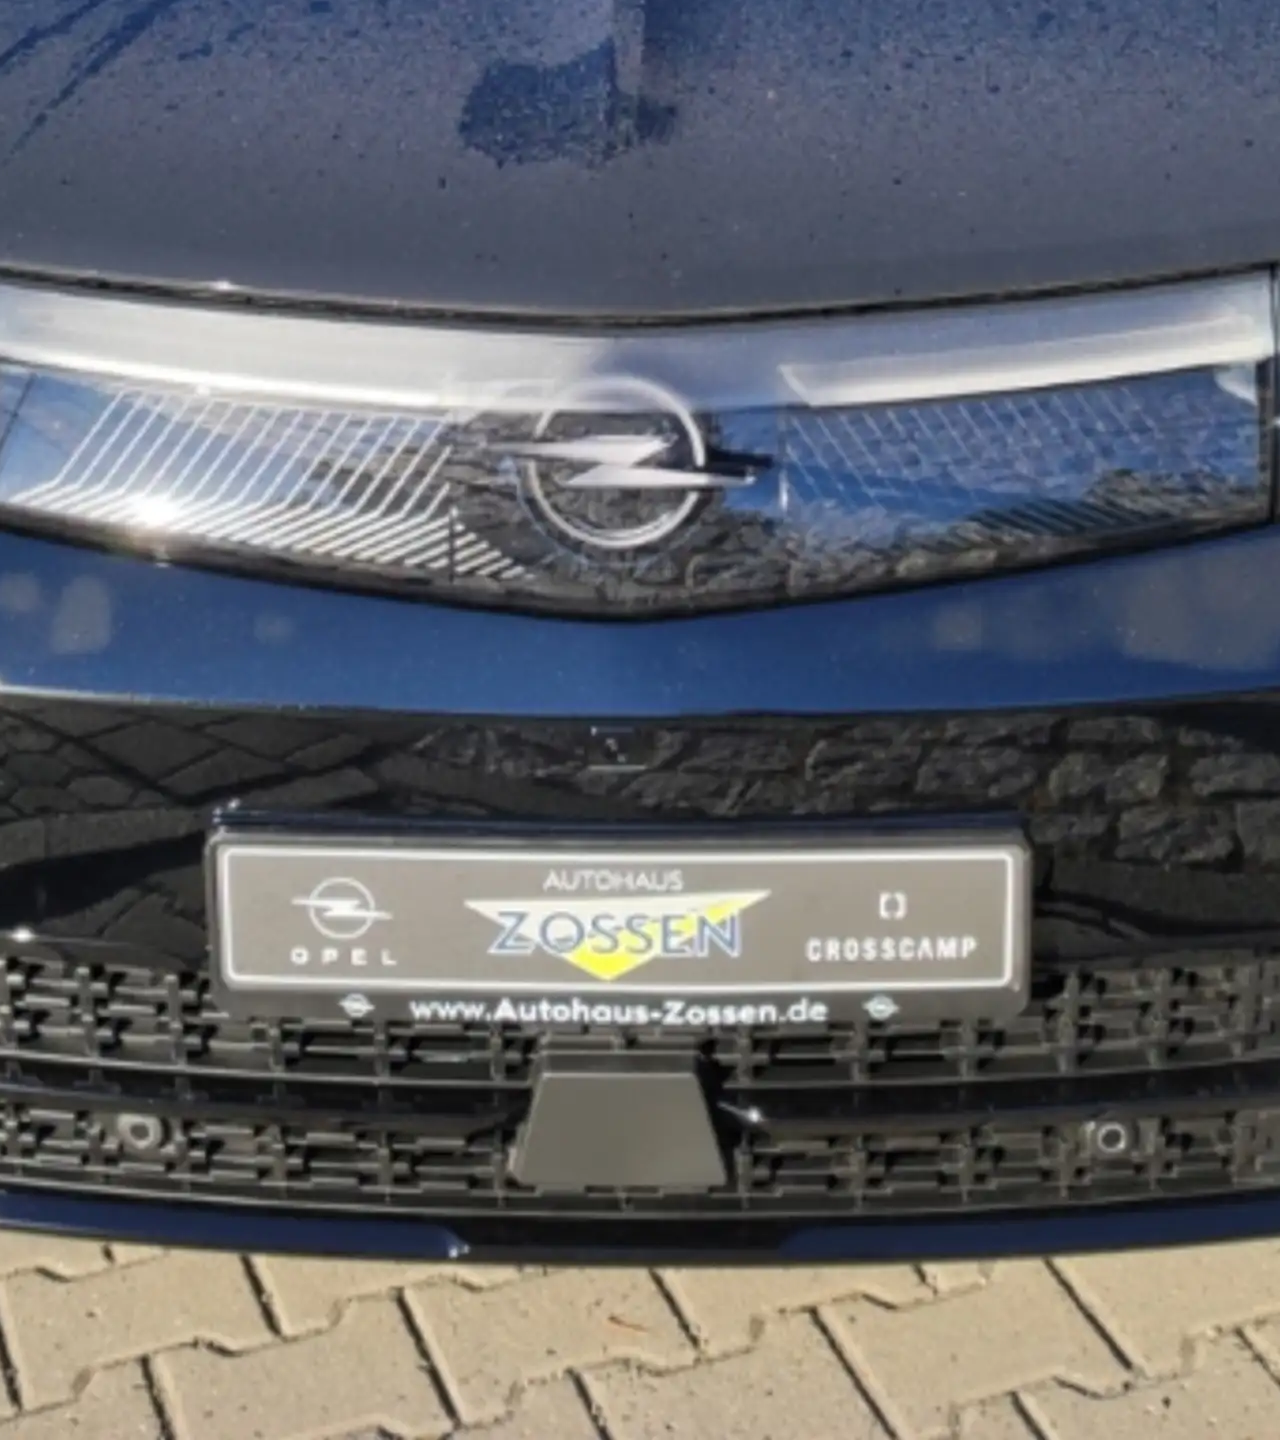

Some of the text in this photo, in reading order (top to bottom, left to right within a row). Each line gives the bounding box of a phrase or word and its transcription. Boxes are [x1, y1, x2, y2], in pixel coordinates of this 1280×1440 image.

[543, 869, 684, 891] AUTOHAUS
[488, 910, 742, 957] ZOSSEN
[290, 946, 398, 966] OPEL
[805, 935, 979, 962] CROSSCAMP
[409, 997, 830, 1024] www.Autohaus-Zossen.de
